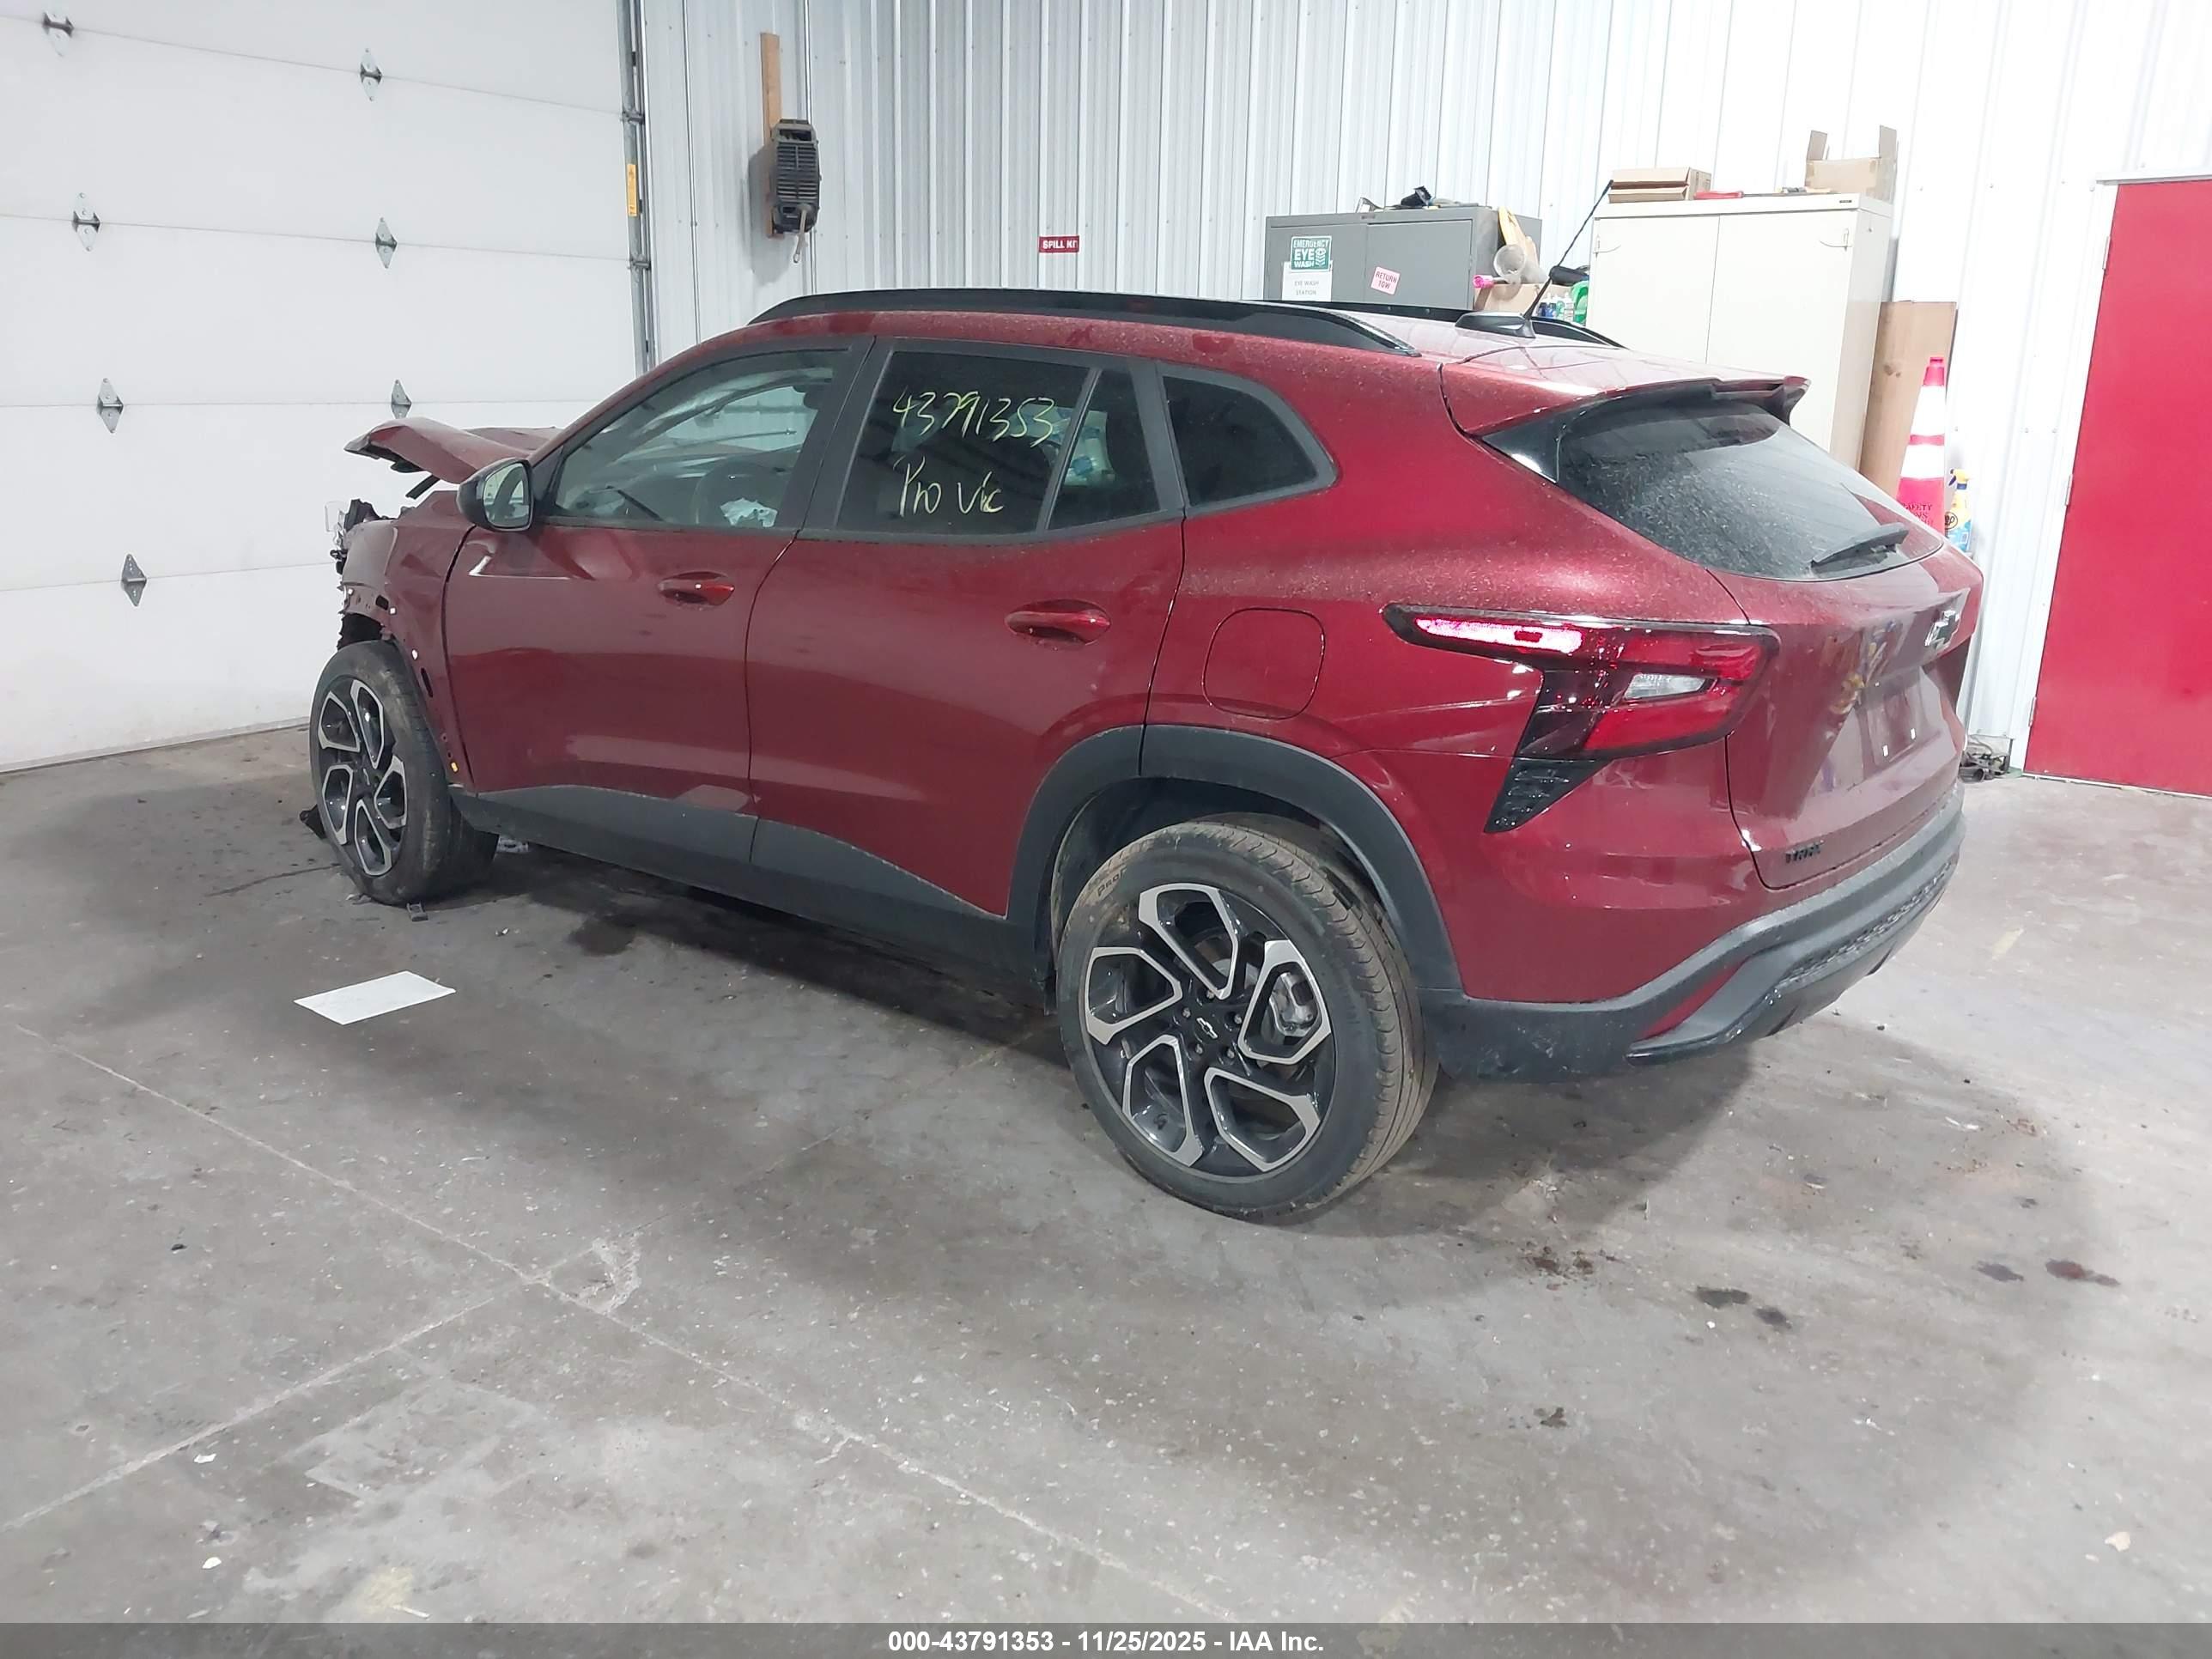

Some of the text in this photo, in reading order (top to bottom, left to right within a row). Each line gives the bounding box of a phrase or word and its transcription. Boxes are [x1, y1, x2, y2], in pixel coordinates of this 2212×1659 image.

[1042, 240, 1065, 249] SPILL
[1293, 240, 1328, 248] EMERGENCY
[1294, 248, 1316, 261] EYE
[1294, 260, 1316, 269] WASH
[1376, 270, 1398, 284] RETURN
[1377, 280, 1391, 289] TOW
[893, 385, 1055, 448] 43791353
